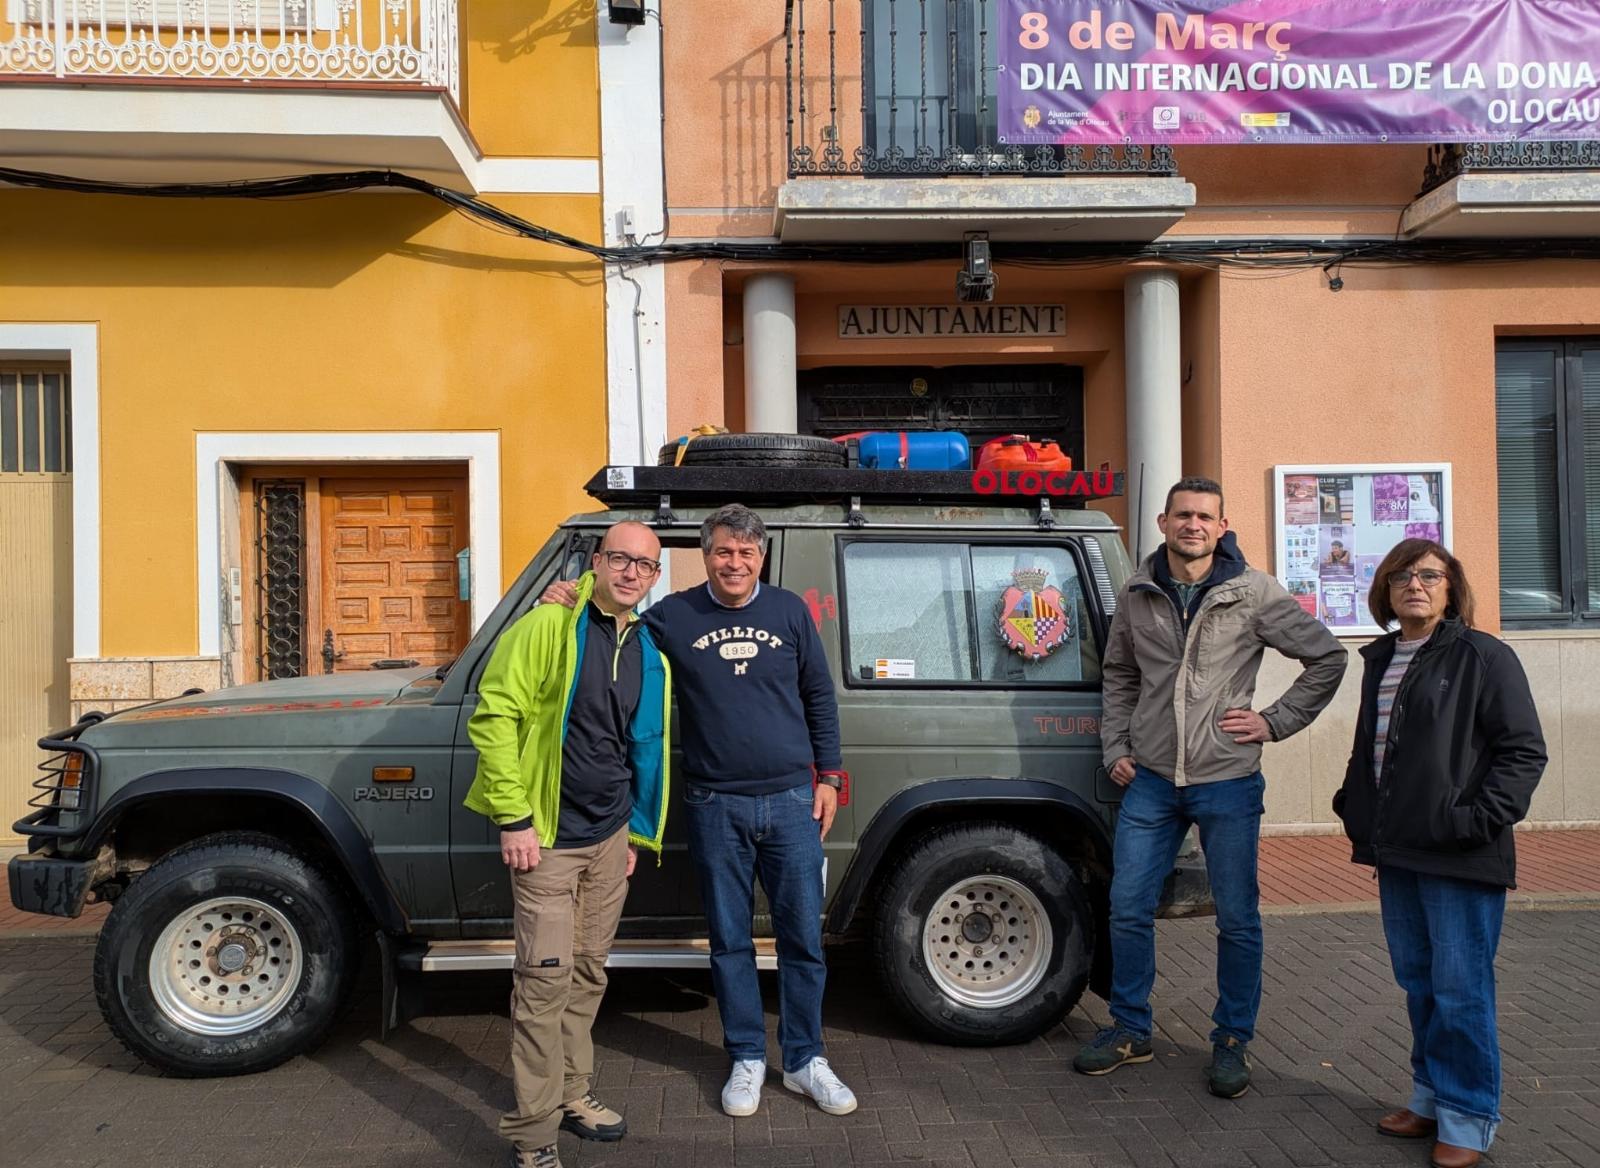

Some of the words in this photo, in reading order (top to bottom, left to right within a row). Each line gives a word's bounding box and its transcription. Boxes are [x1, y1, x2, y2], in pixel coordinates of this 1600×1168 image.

[1019, 12, 1049, 49] 8
[1068, 10, 1136, 49] de
[1155, 13, 1291, 61] Març
[1020, 62, 1082, 91] DIA
[1094, 61, 1377, 91] INTERNACIONAL
[1388, 62, 1432, 91] DE
[1442, 62, 1486, 90] LA
[1496, 61, 1597, 89] DONA
[1487, 98, 1600, 124] OLOCAU
[692, 626, 783, 651] WILLIOT
[725, 646, 754, 656] 1950
[354, 786, 434, 801] PAJERO
